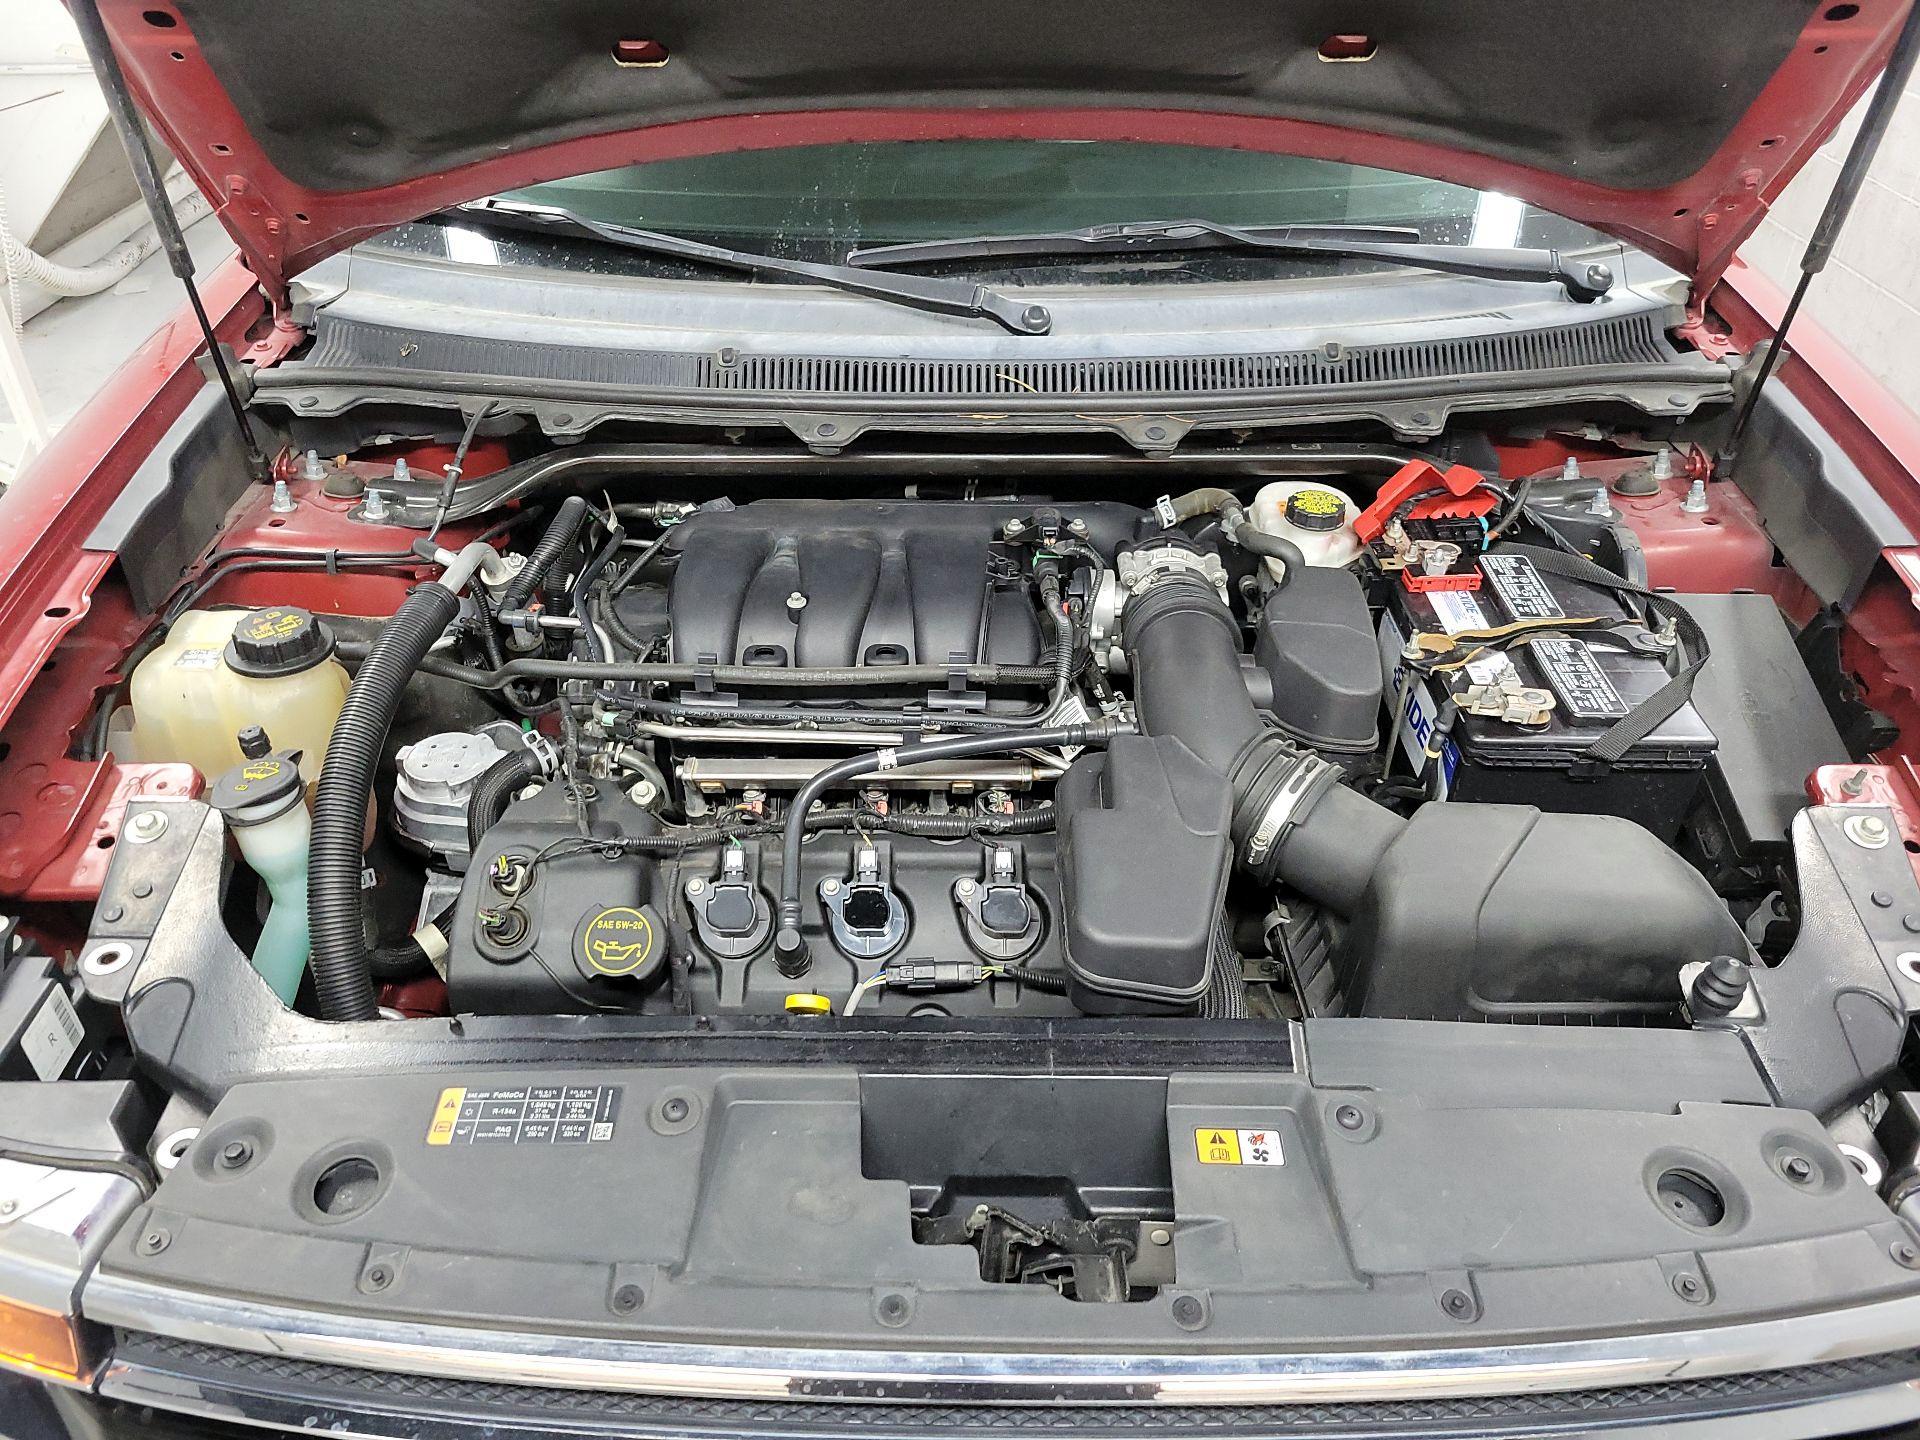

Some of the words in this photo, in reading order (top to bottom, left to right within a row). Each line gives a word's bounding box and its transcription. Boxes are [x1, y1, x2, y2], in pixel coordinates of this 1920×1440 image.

[1393, 665, 1431, 751] EIDE
[597, 920, 615, 929] SAE
[615, 920, 644, 930] 5W-20
[493, 1091, 525, 1099] FoMoCo
[492, 1107, 517, 1115] R-134a
